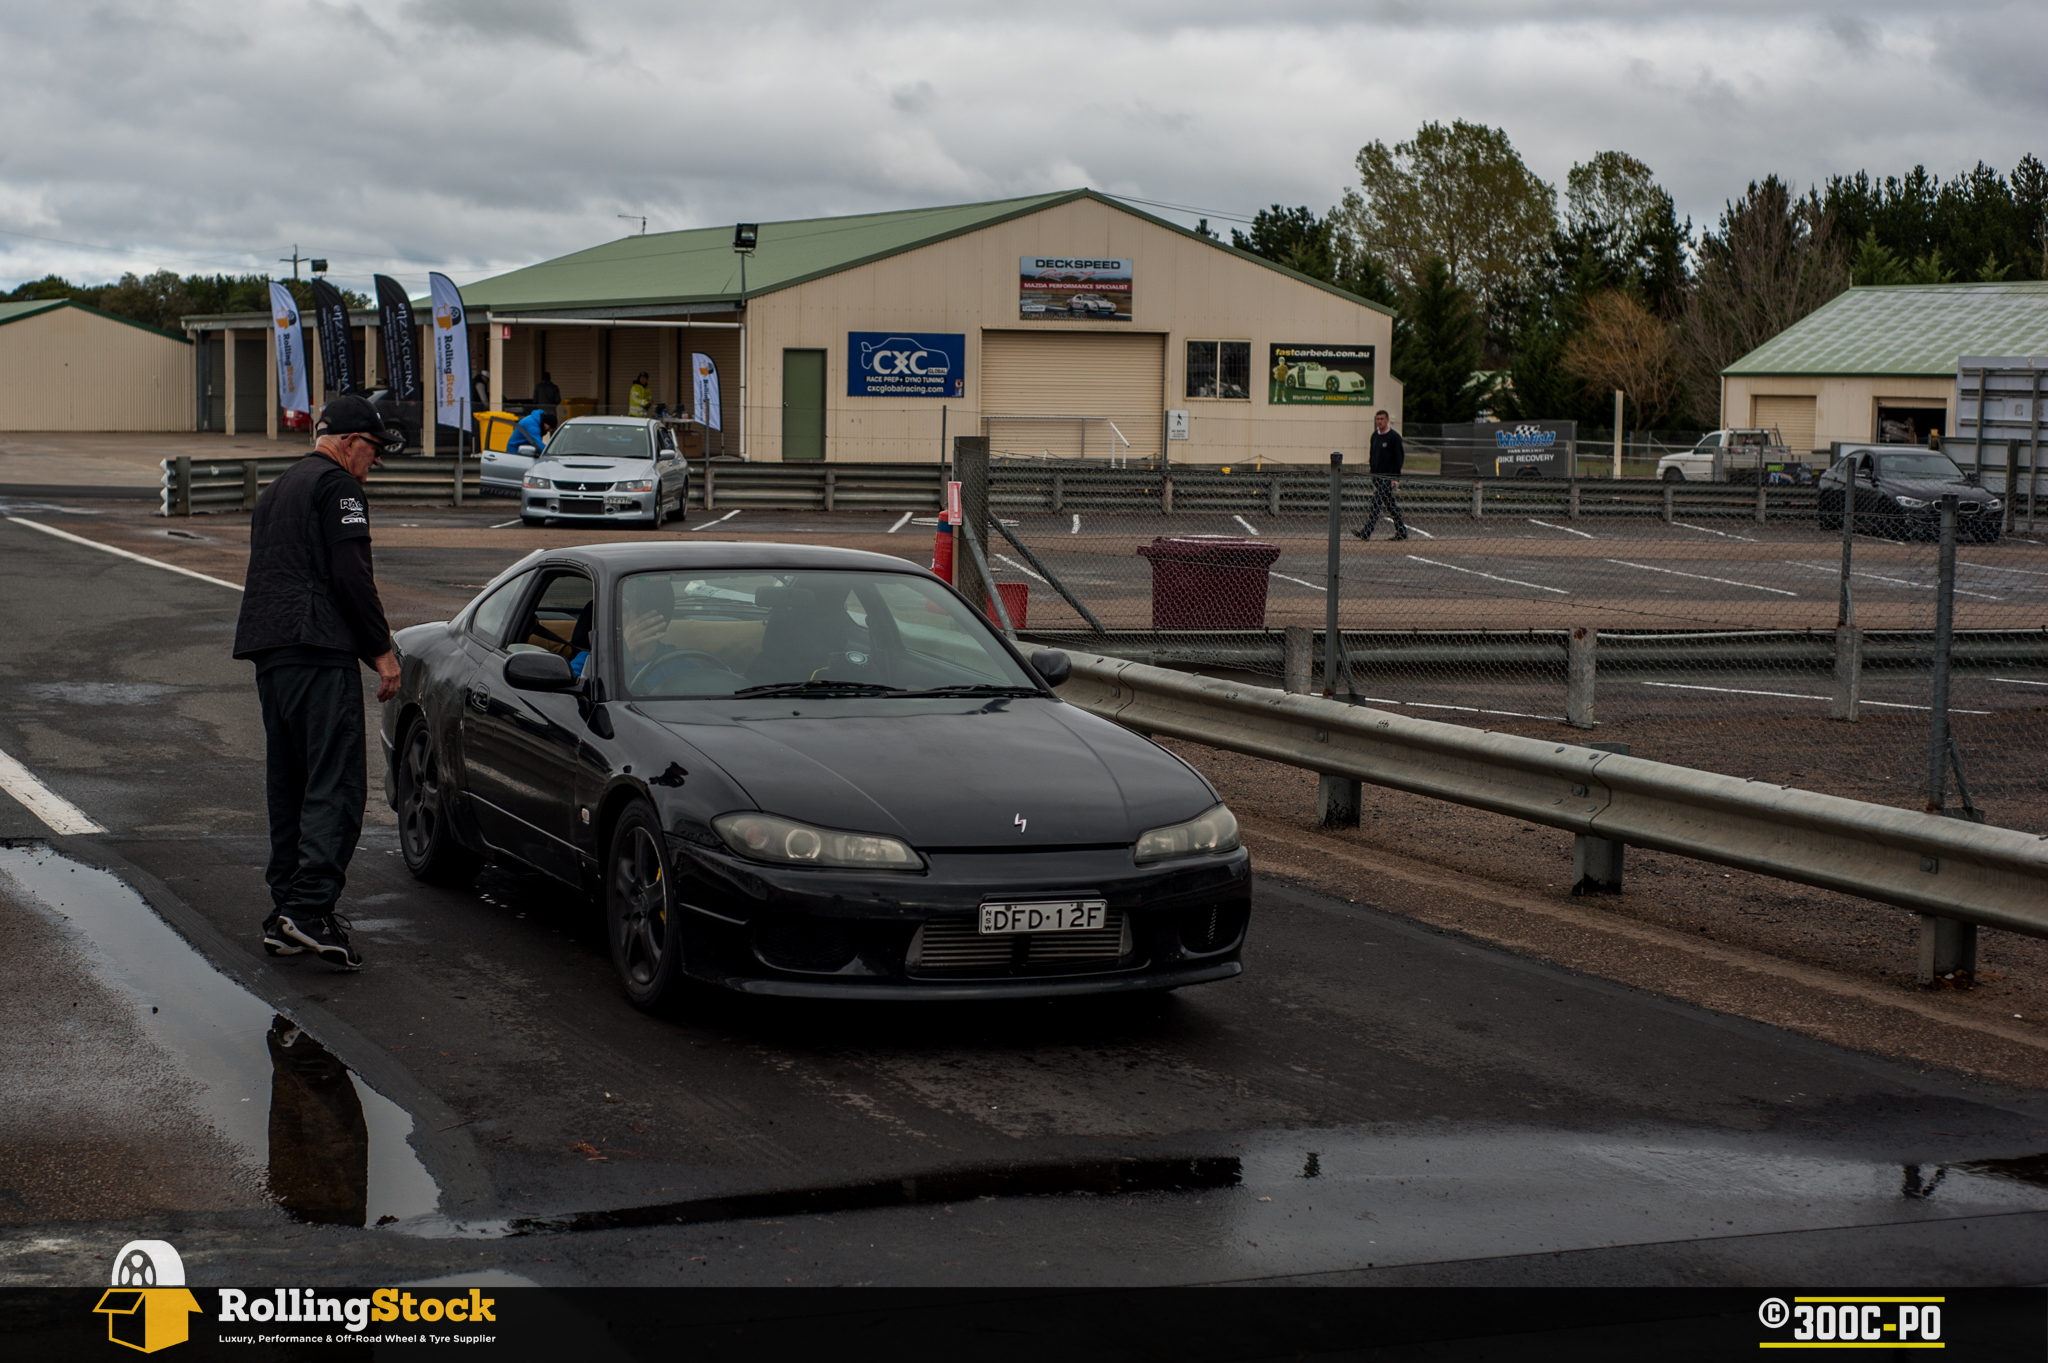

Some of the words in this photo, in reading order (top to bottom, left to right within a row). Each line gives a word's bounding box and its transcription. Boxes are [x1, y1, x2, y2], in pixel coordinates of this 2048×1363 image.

[1035, 259, 1121, 269] DECKSPEED
[1275, 348, 1370, 358] fastcarbeds.com.au
[283, 333, 296, 394] RollingStock
[872, 350, 928, 374] CXC
[444, 335, 456, 408] RollingStock
[867, 384, 944, 394] cxcglobalracing.com
[1516, 454, 1554, 462] RECOVERY
